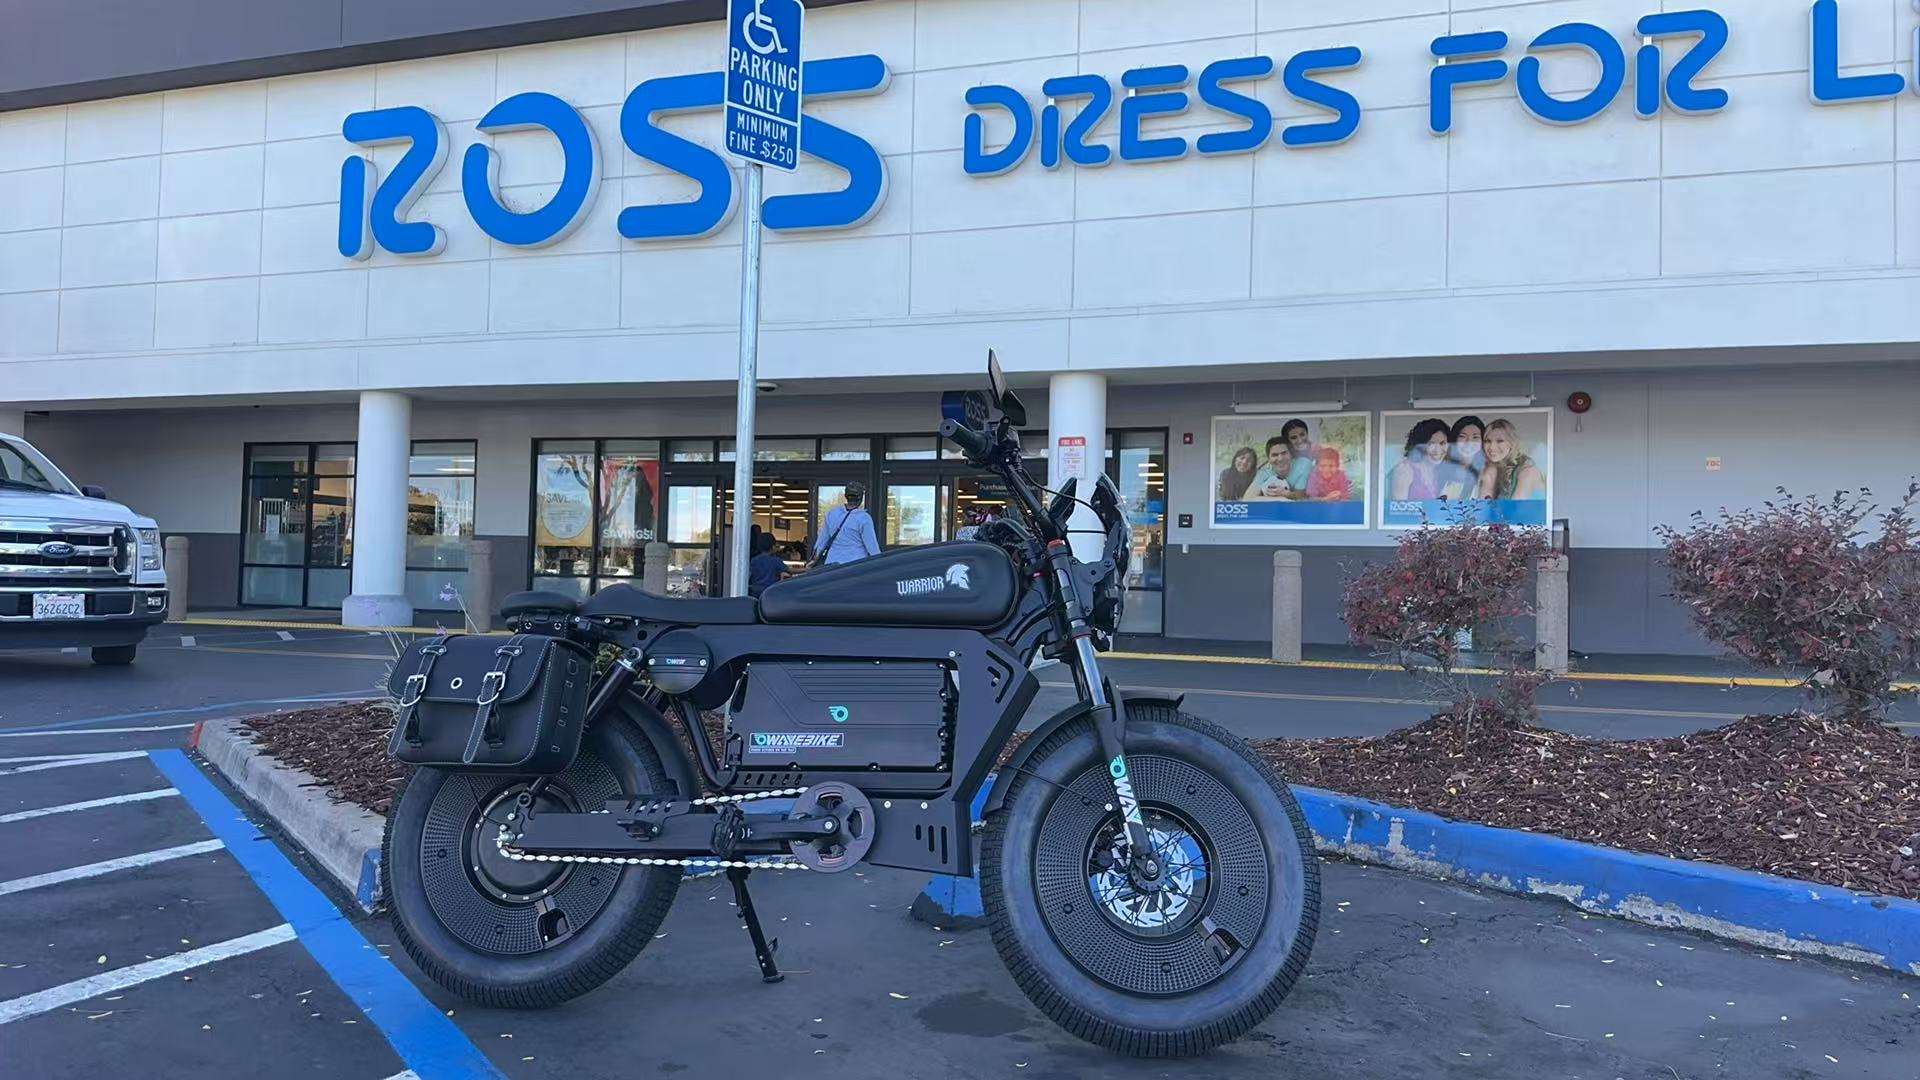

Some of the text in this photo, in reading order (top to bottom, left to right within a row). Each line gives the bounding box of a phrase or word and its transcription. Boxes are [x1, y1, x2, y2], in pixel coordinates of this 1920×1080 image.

[730, 47, 798, 92] PARKING
[743, 80, 784, 114] ONLY
[338, 0, 1920, 258] ROSS DRESS FOR L
[737, 112, 788, 142] MINIMUM
[729, 131, 794, 165] FINE $250
[1216, 504, 1248, 514] ROSS
[602, 527, 654, 540] SAVINGS!
[49, 544, 70, 553] Ford
[896, 576, 944, 596] WARRIOR
[38, 603, 80, 615] 36262C2
